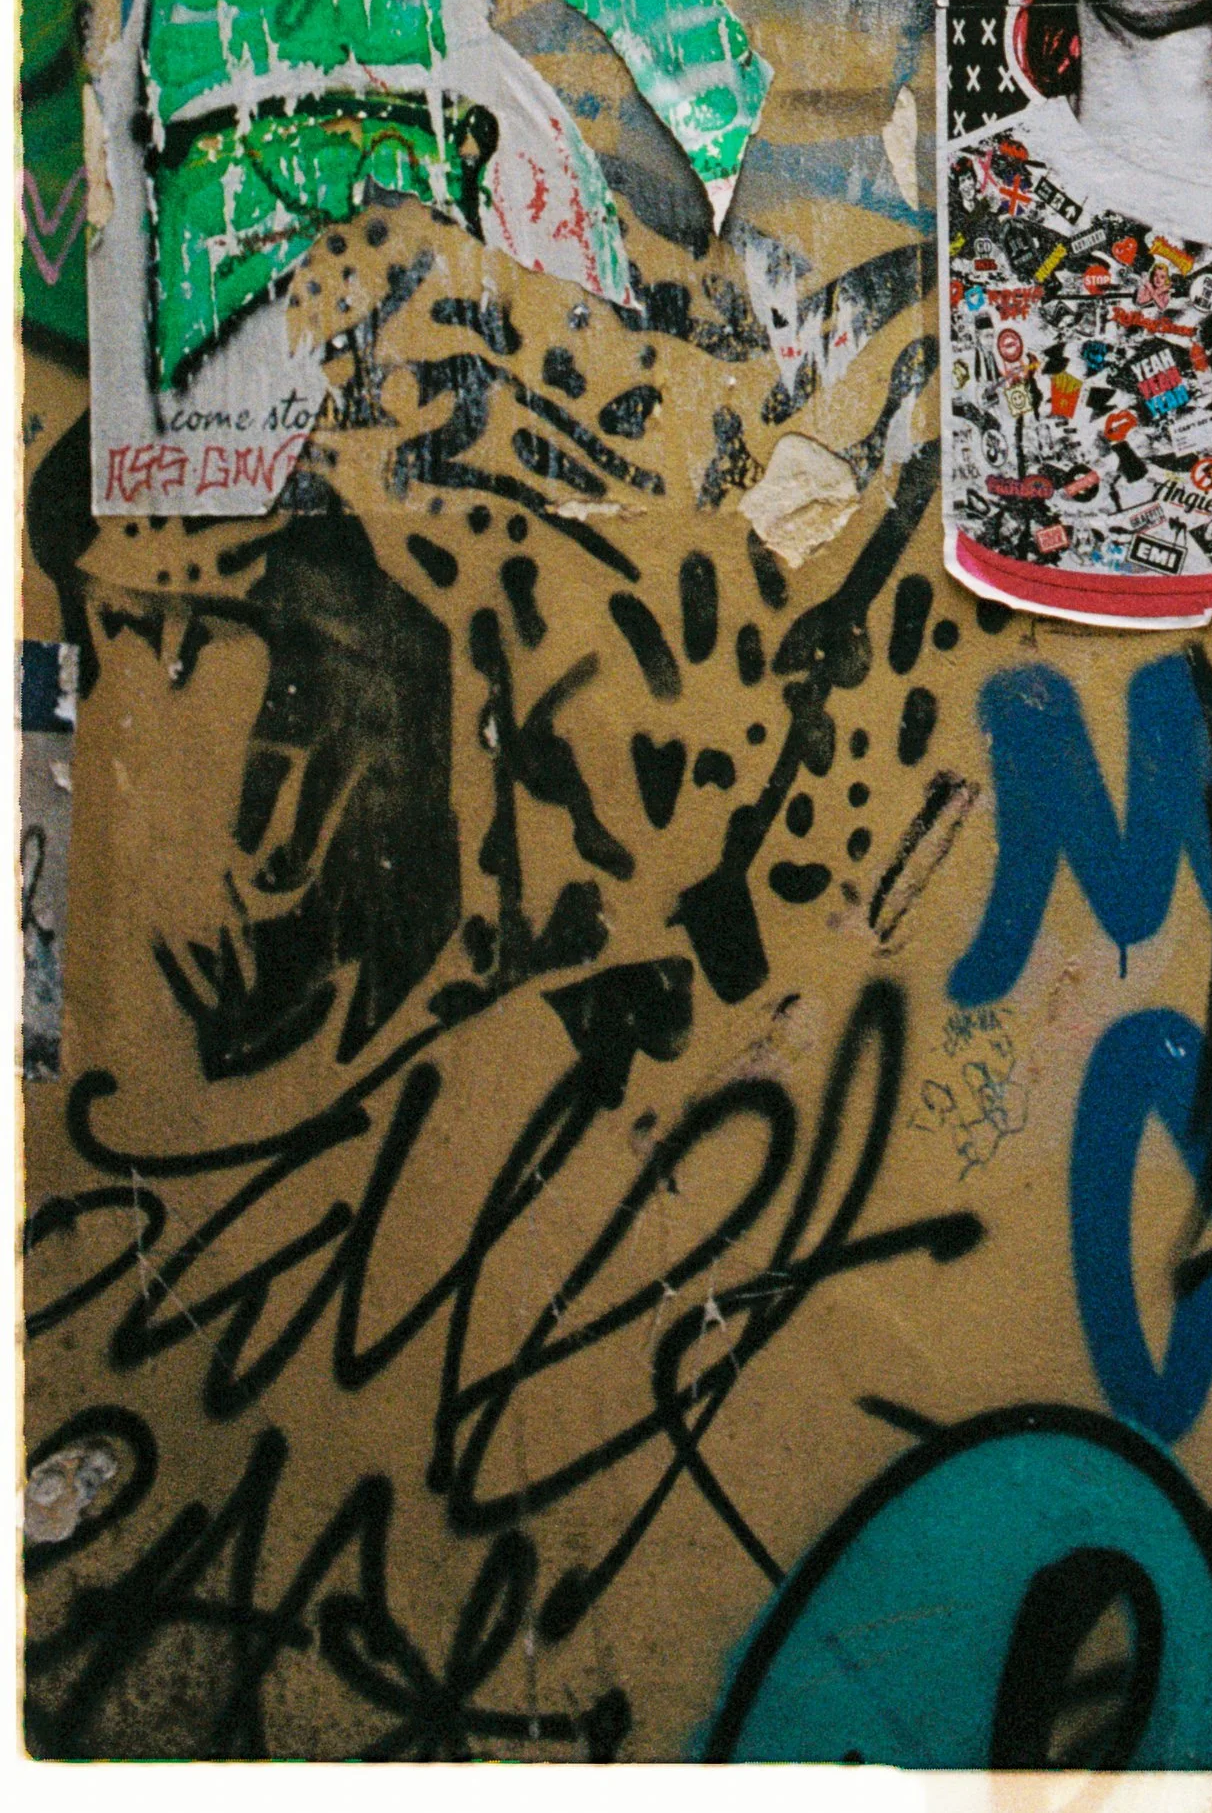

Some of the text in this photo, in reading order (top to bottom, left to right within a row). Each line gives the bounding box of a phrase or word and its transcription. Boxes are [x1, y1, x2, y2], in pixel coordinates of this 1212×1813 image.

[1084, 274, 1111, 286] STOP
[1131, 348, 1176, 382] YEAH
[1138, 366, 1183, 400] YEAH
[169, 408, 253, 433] come
[1136, 543, 1178, 569] EMI
